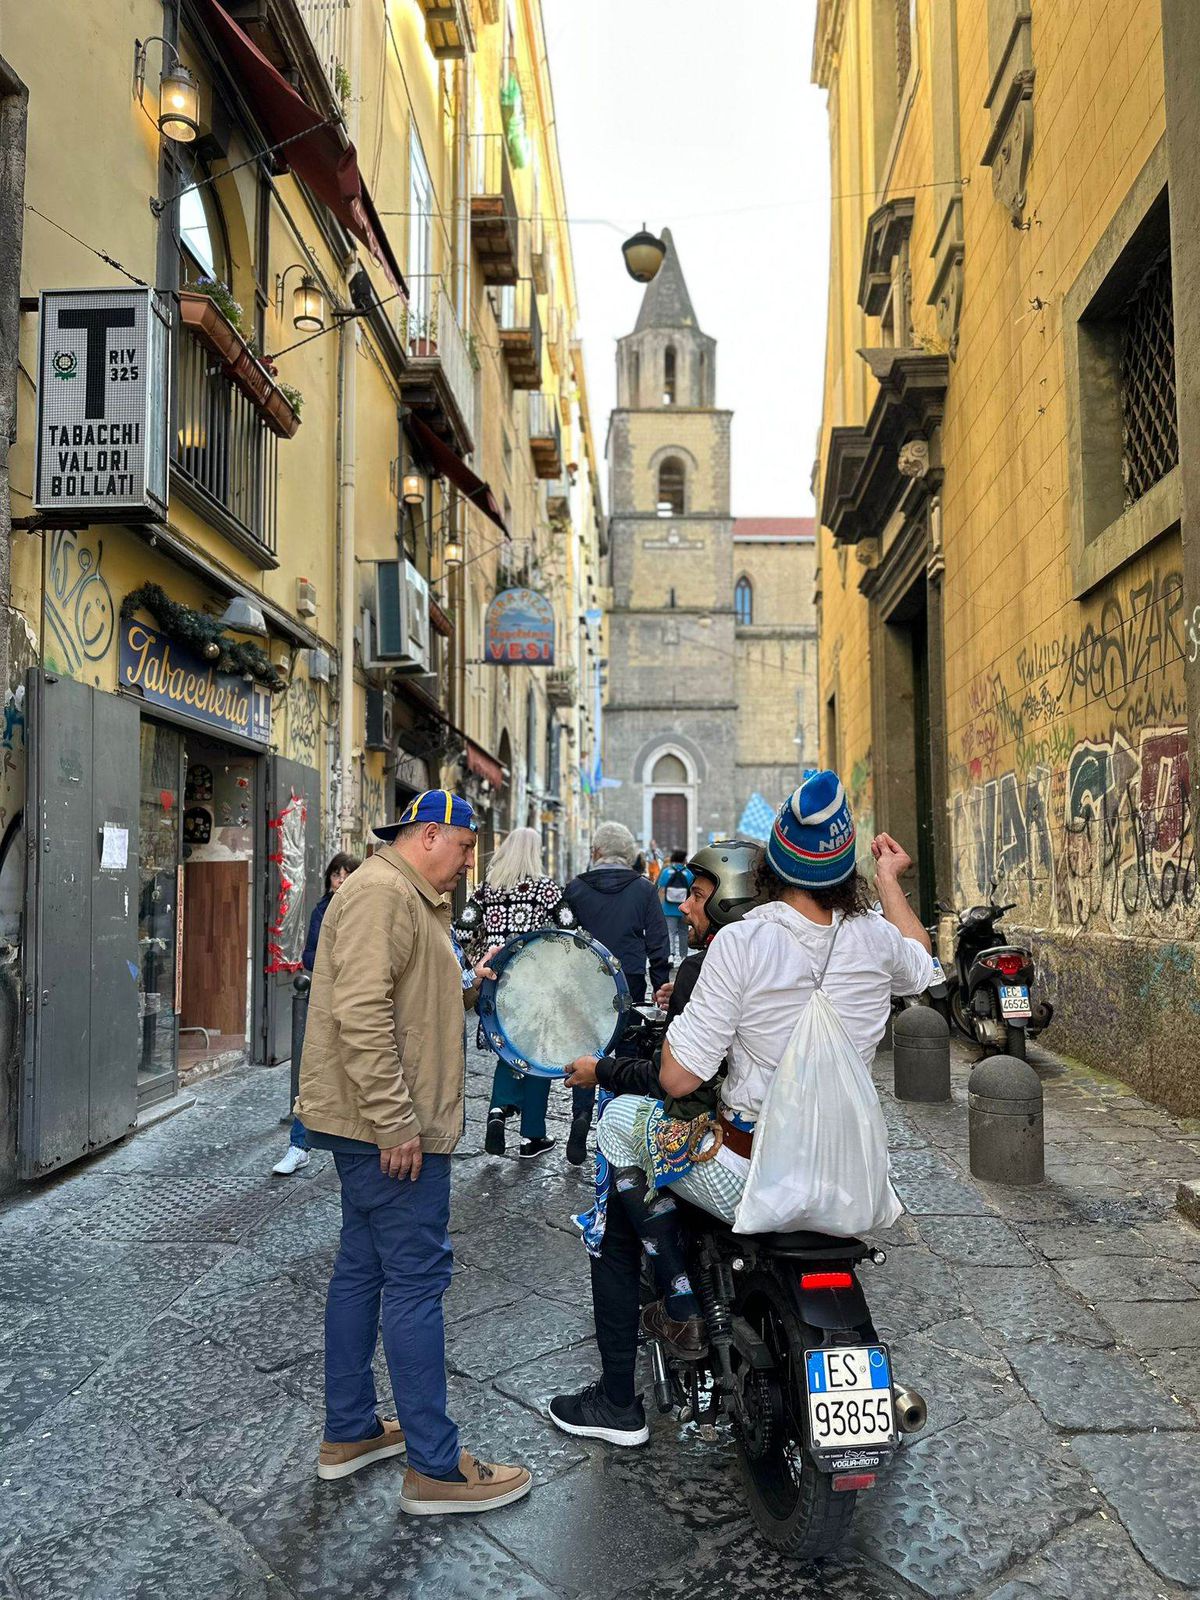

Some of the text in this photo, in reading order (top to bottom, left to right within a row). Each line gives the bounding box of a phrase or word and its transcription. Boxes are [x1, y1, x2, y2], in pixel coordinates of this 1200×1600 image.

[58, 308, 135, 419] T
[109, 349, 136, 364] RIV
[110, 366, 138, 381] 325
[49, 423, 139, 446] TABACCHI
[58, 450, 127, 472] VALORI
[51, 474, 133, 496] BOLLATI
[489, 640, 549, 660] VESI
[127, 626, 249, 726] Tabaccheria
[1003, 999, 1029, 1009] 46525
[827, 1353, 858, 1387] ES
[815, 1398, 890, 1437] 93855
